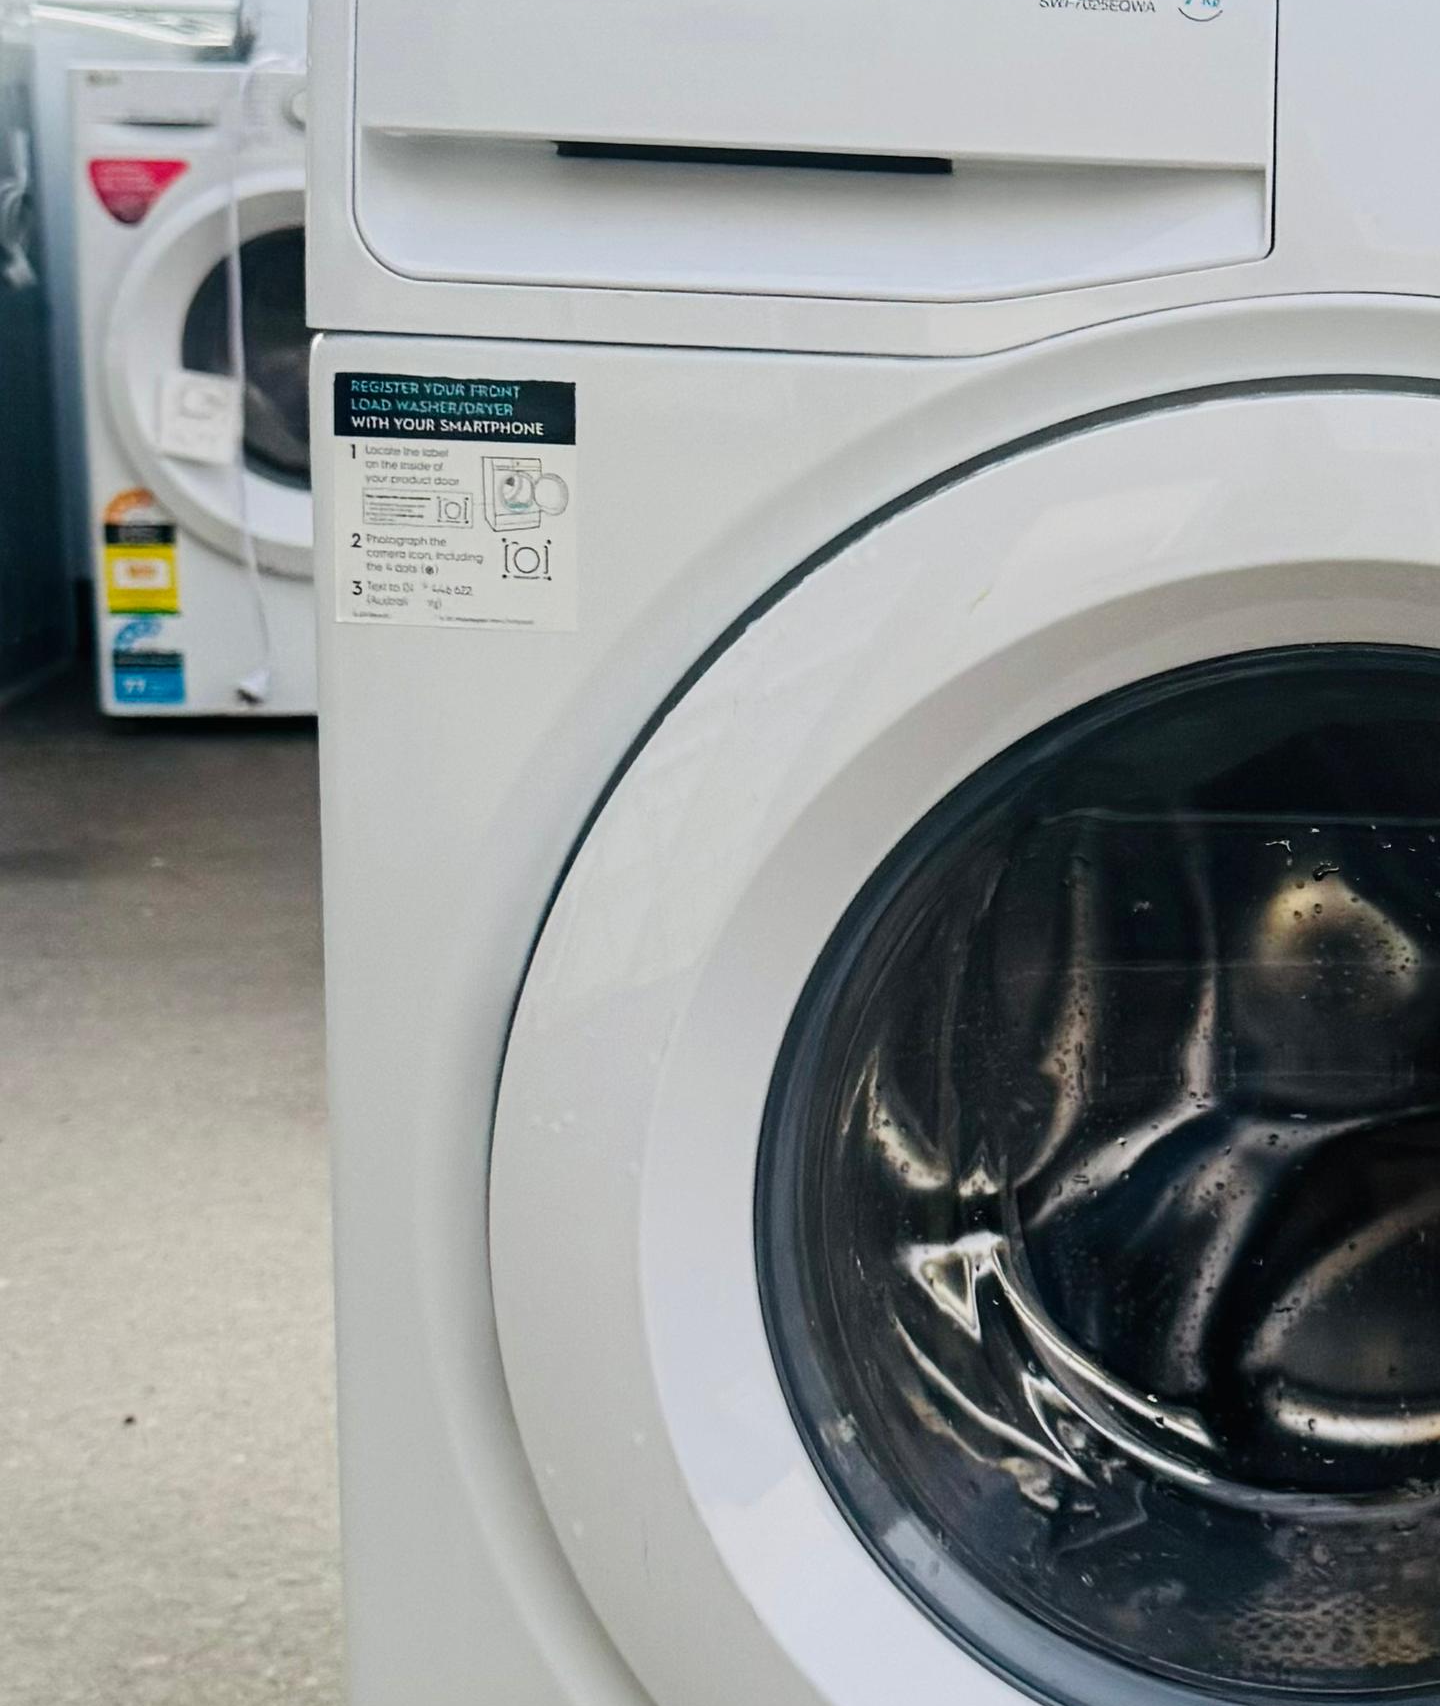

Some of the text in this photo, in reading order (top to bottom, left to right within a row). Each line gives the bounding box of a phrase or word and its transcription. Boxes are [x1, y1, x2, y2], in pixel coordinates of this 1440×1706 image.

[351, 380, 521, 398] REGISTER YOUR FRONT
[351, 399, 513, 416] LOAD WASHER/DRYER
[351, 416, 544, 435] WITH YOUR SMARTPHONE
[350, 444, 357, 459] 1
[350, 533, 362, 548] 2
[352, 581, 363, 595] 3
